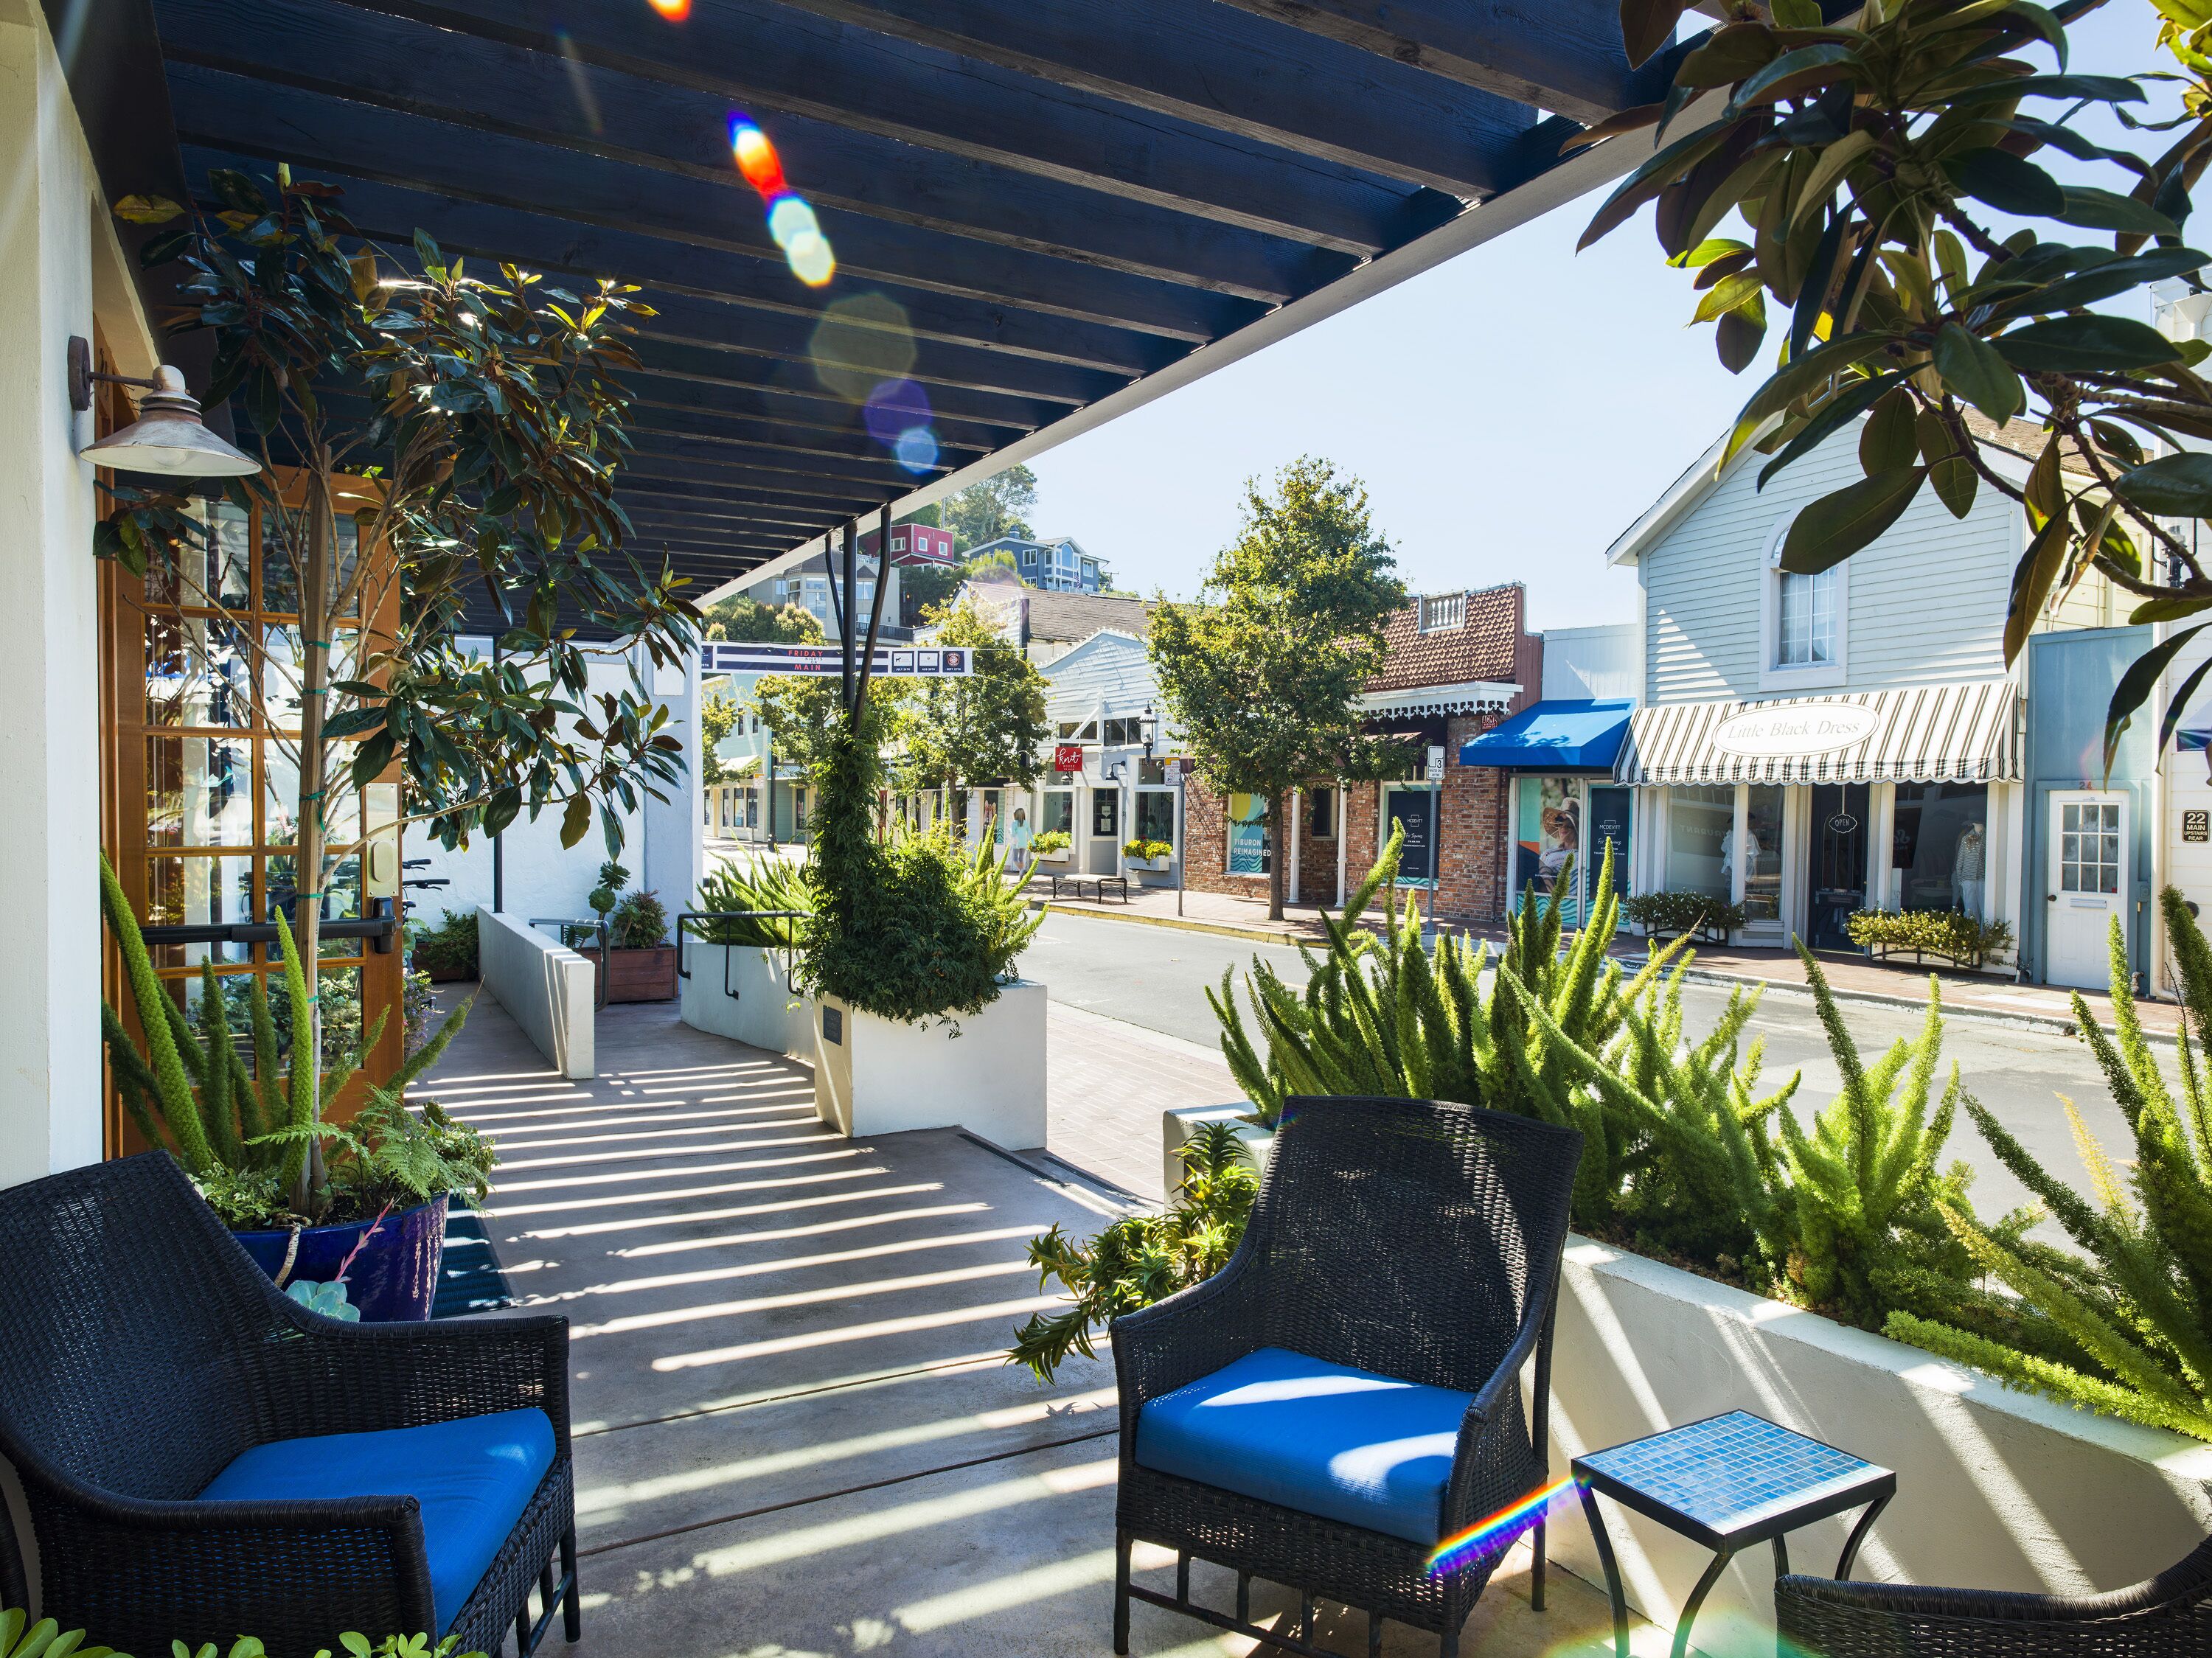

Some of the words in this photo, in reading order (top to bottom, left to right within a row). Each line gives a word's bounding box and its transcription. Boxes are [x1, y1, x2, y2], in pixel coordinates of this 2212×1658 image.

[1728, 723, 1764, 739] Little
[1770, 720, 1811, 736] Black
[1816, 720, 1860, 735] Dress
[1437, 760, 1441, 768] 3
[2079, 781, 2092, 790] 24
[2187, 813, 2206, 824] 22
[1234, 848, 1271, 857] REIMAGINED
